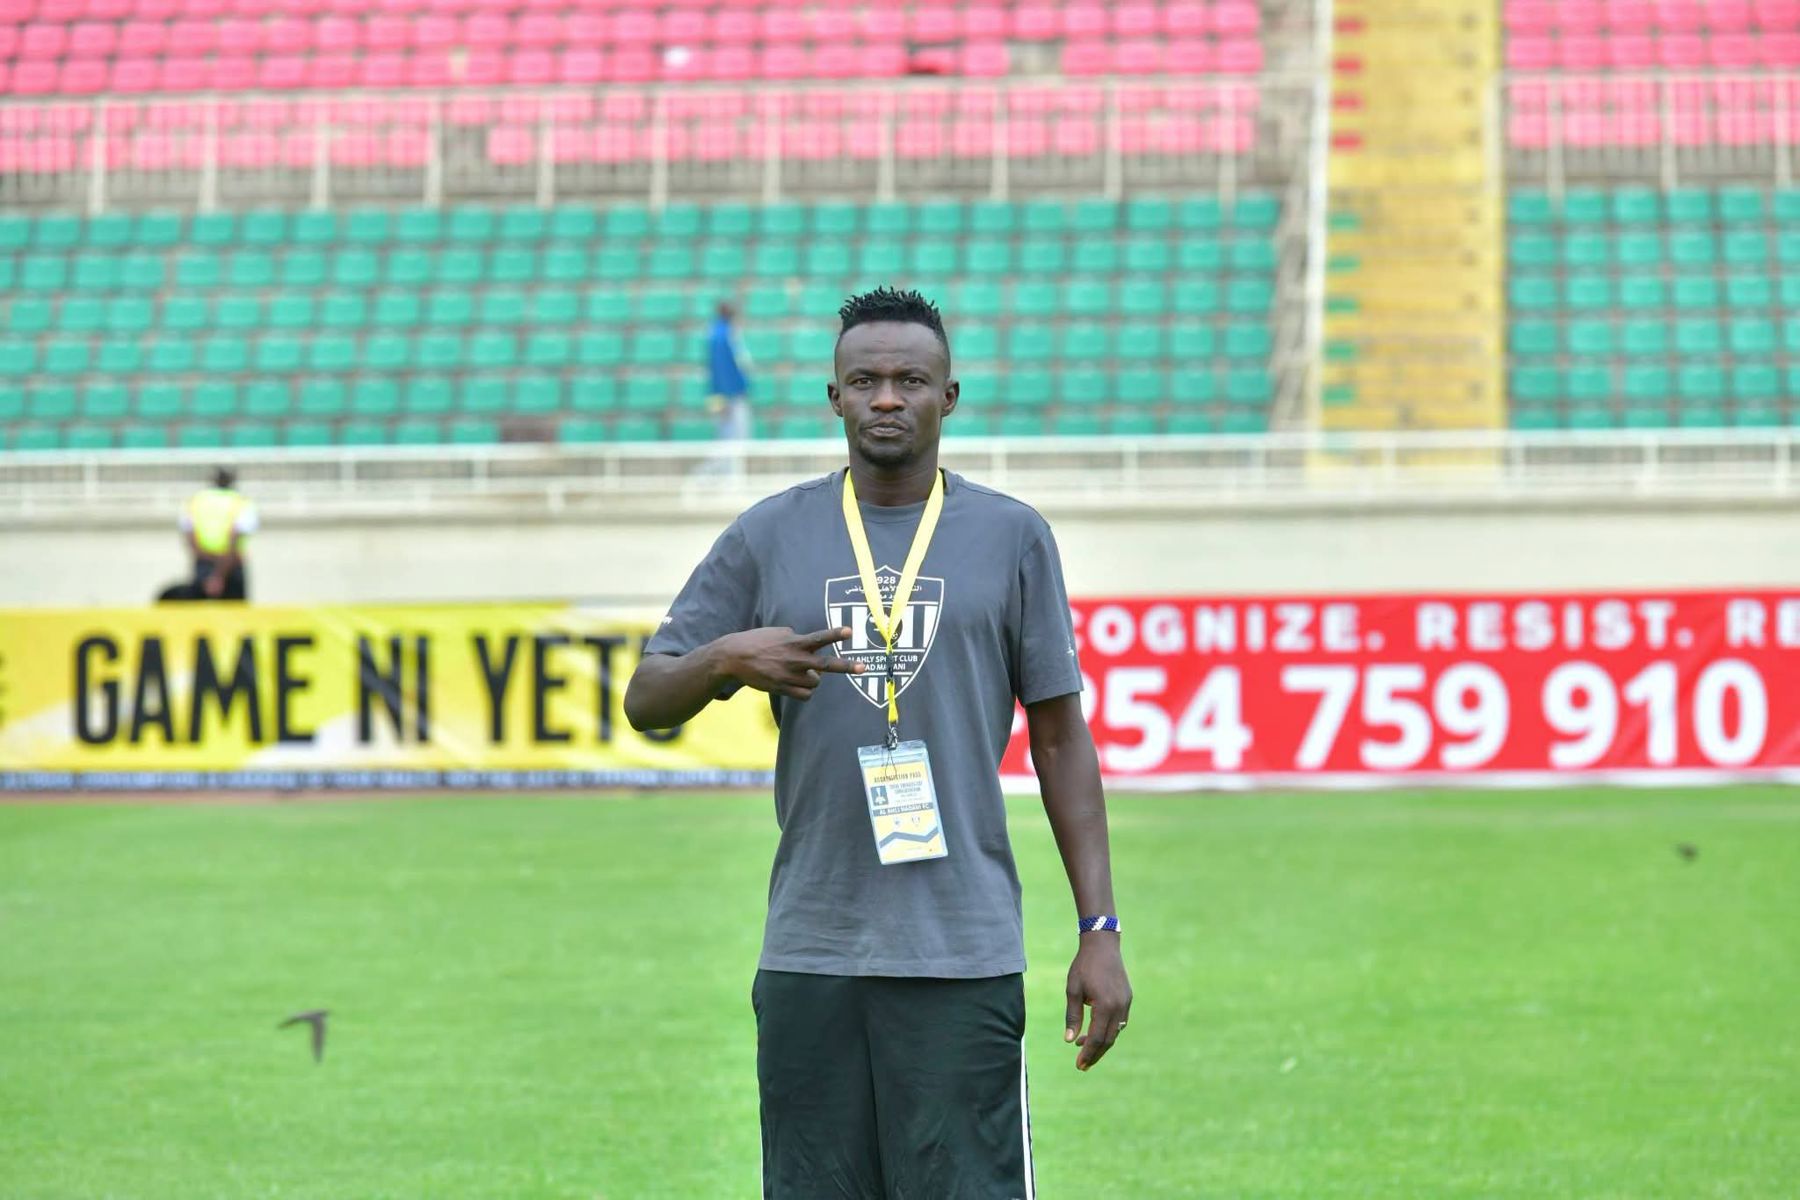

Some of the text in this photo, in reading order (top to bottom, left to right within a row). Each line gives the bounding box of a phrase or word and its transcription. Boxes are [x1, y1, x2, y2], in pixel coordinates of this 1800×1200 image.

[877, 576, 896, 584] 928
[1417, 600, 1694, 650] RESIST.
[1726, 598, 1800, 648] RE
[856, 655, 874, 663] AHLY
[74, 636, 316, 744] GAME
[358, 636, 430, 742] NI
[1281, 663, 1509, 770] 759
[1541, 660, 1768, 767] 910
